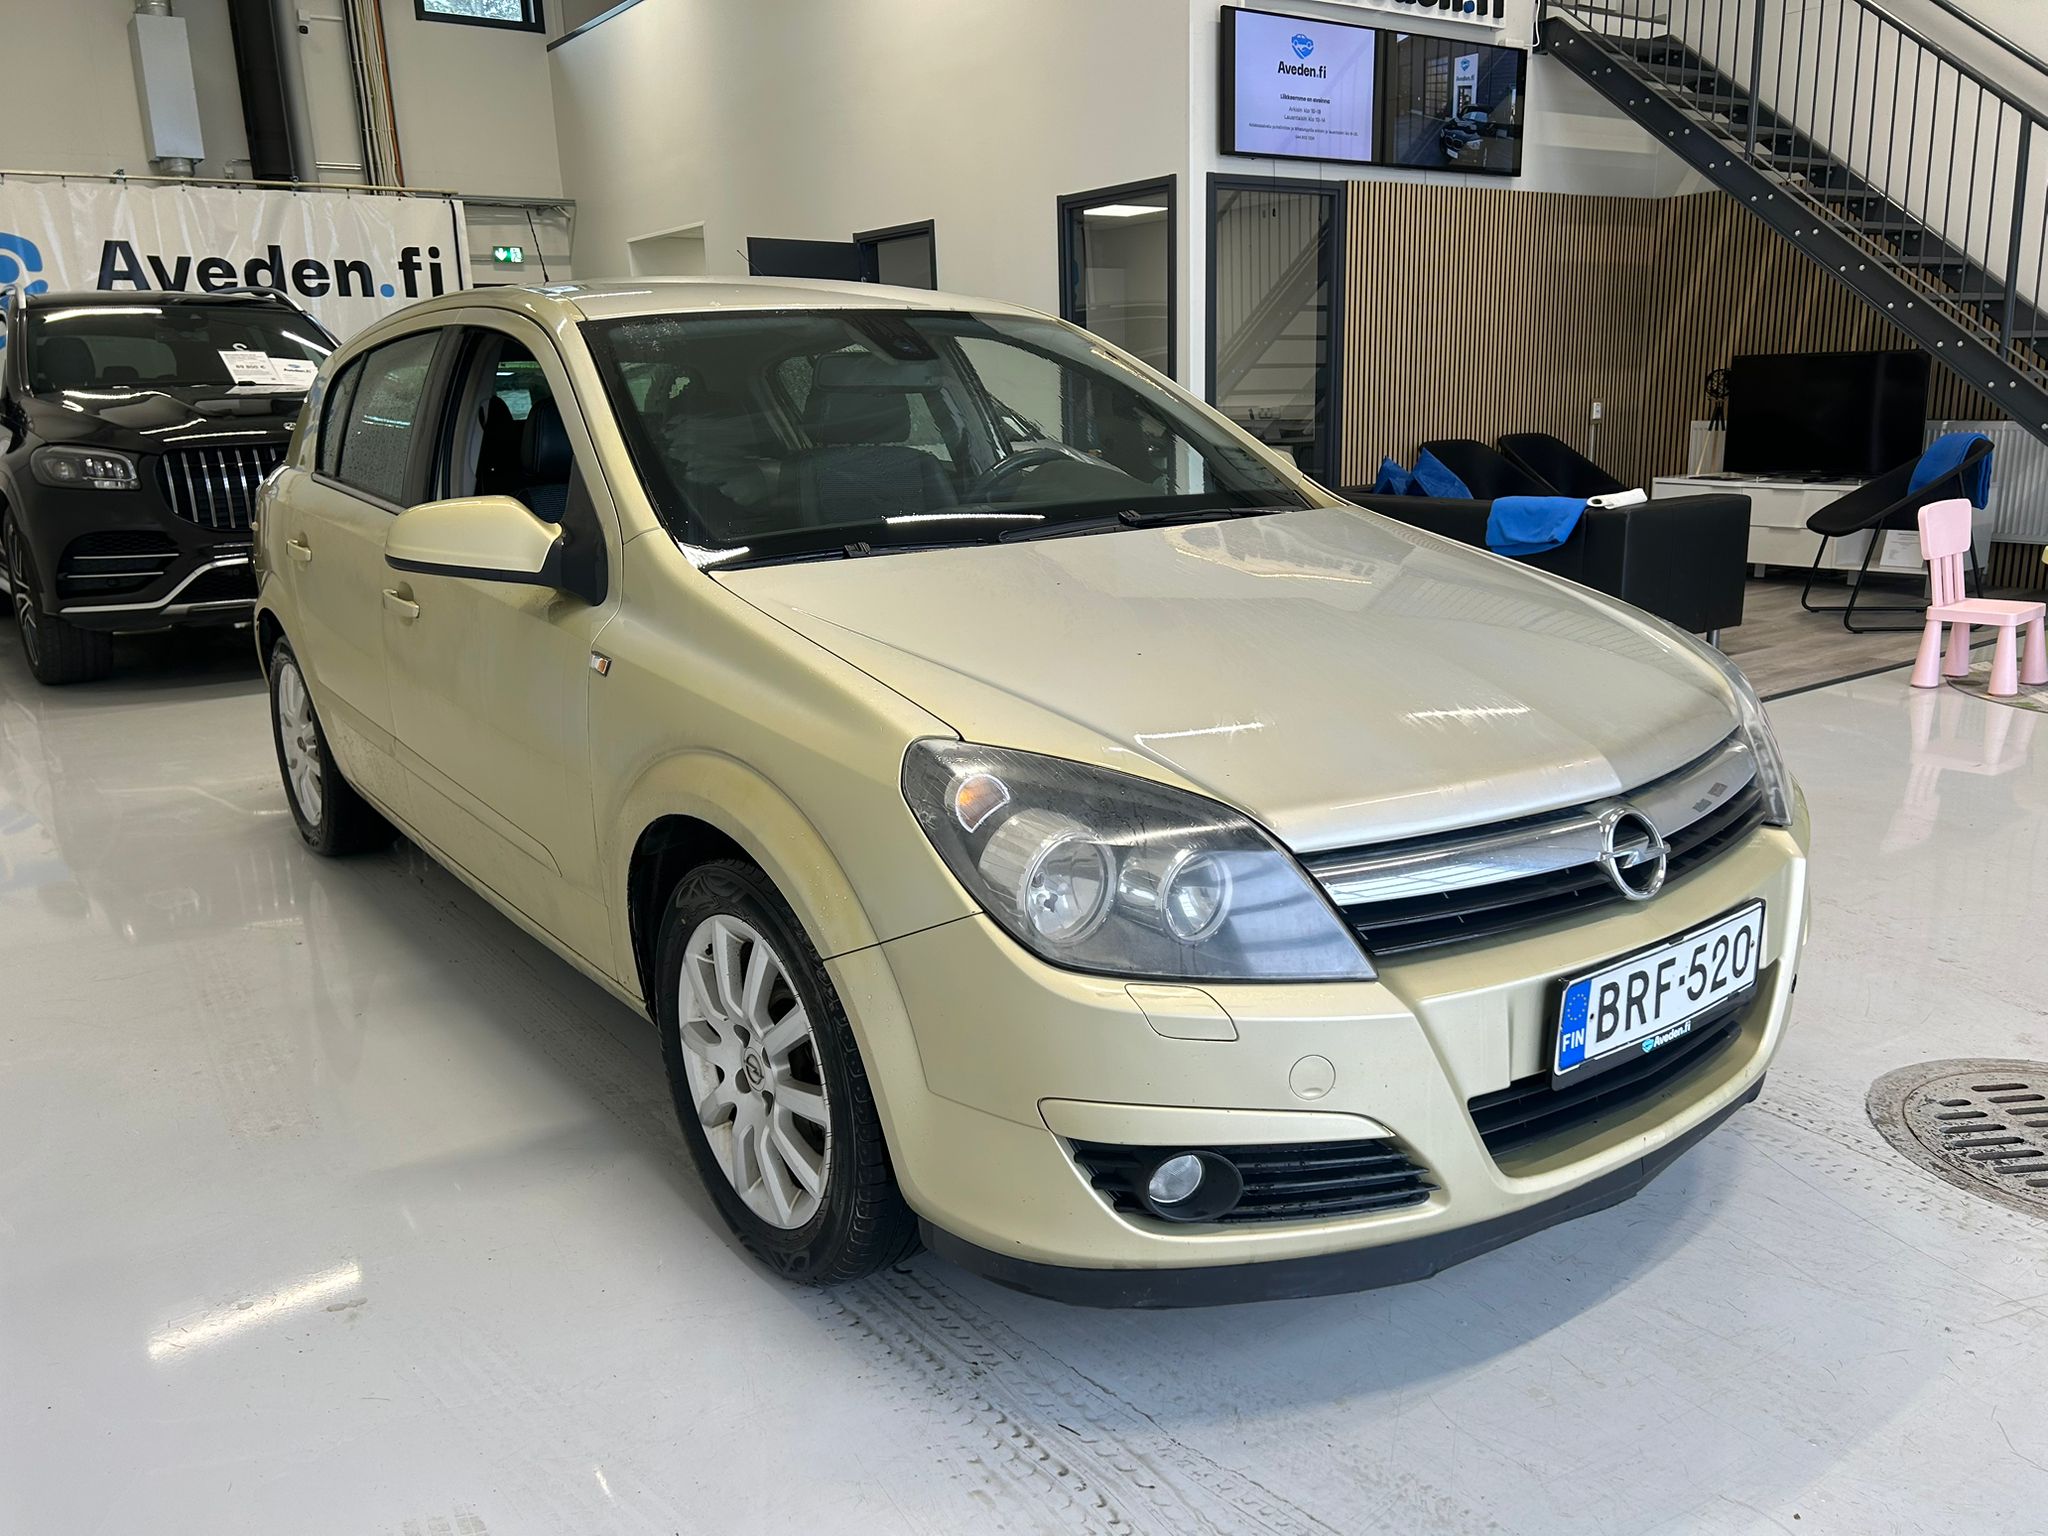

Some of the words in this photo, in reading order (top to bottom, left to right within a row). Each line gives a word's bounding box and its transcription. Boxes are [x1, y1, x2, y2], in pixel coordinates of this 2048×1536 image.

[1278, 61, 1327, 79] Aveden.fi
[97, 240, 444, 298] Aveden.fi
[1595, 925, 1751, 1043] BRF-520
[1562, 1028, 1585, 1052] FIN
[1653, 1020, 1691, 1048] Aveden.fi
